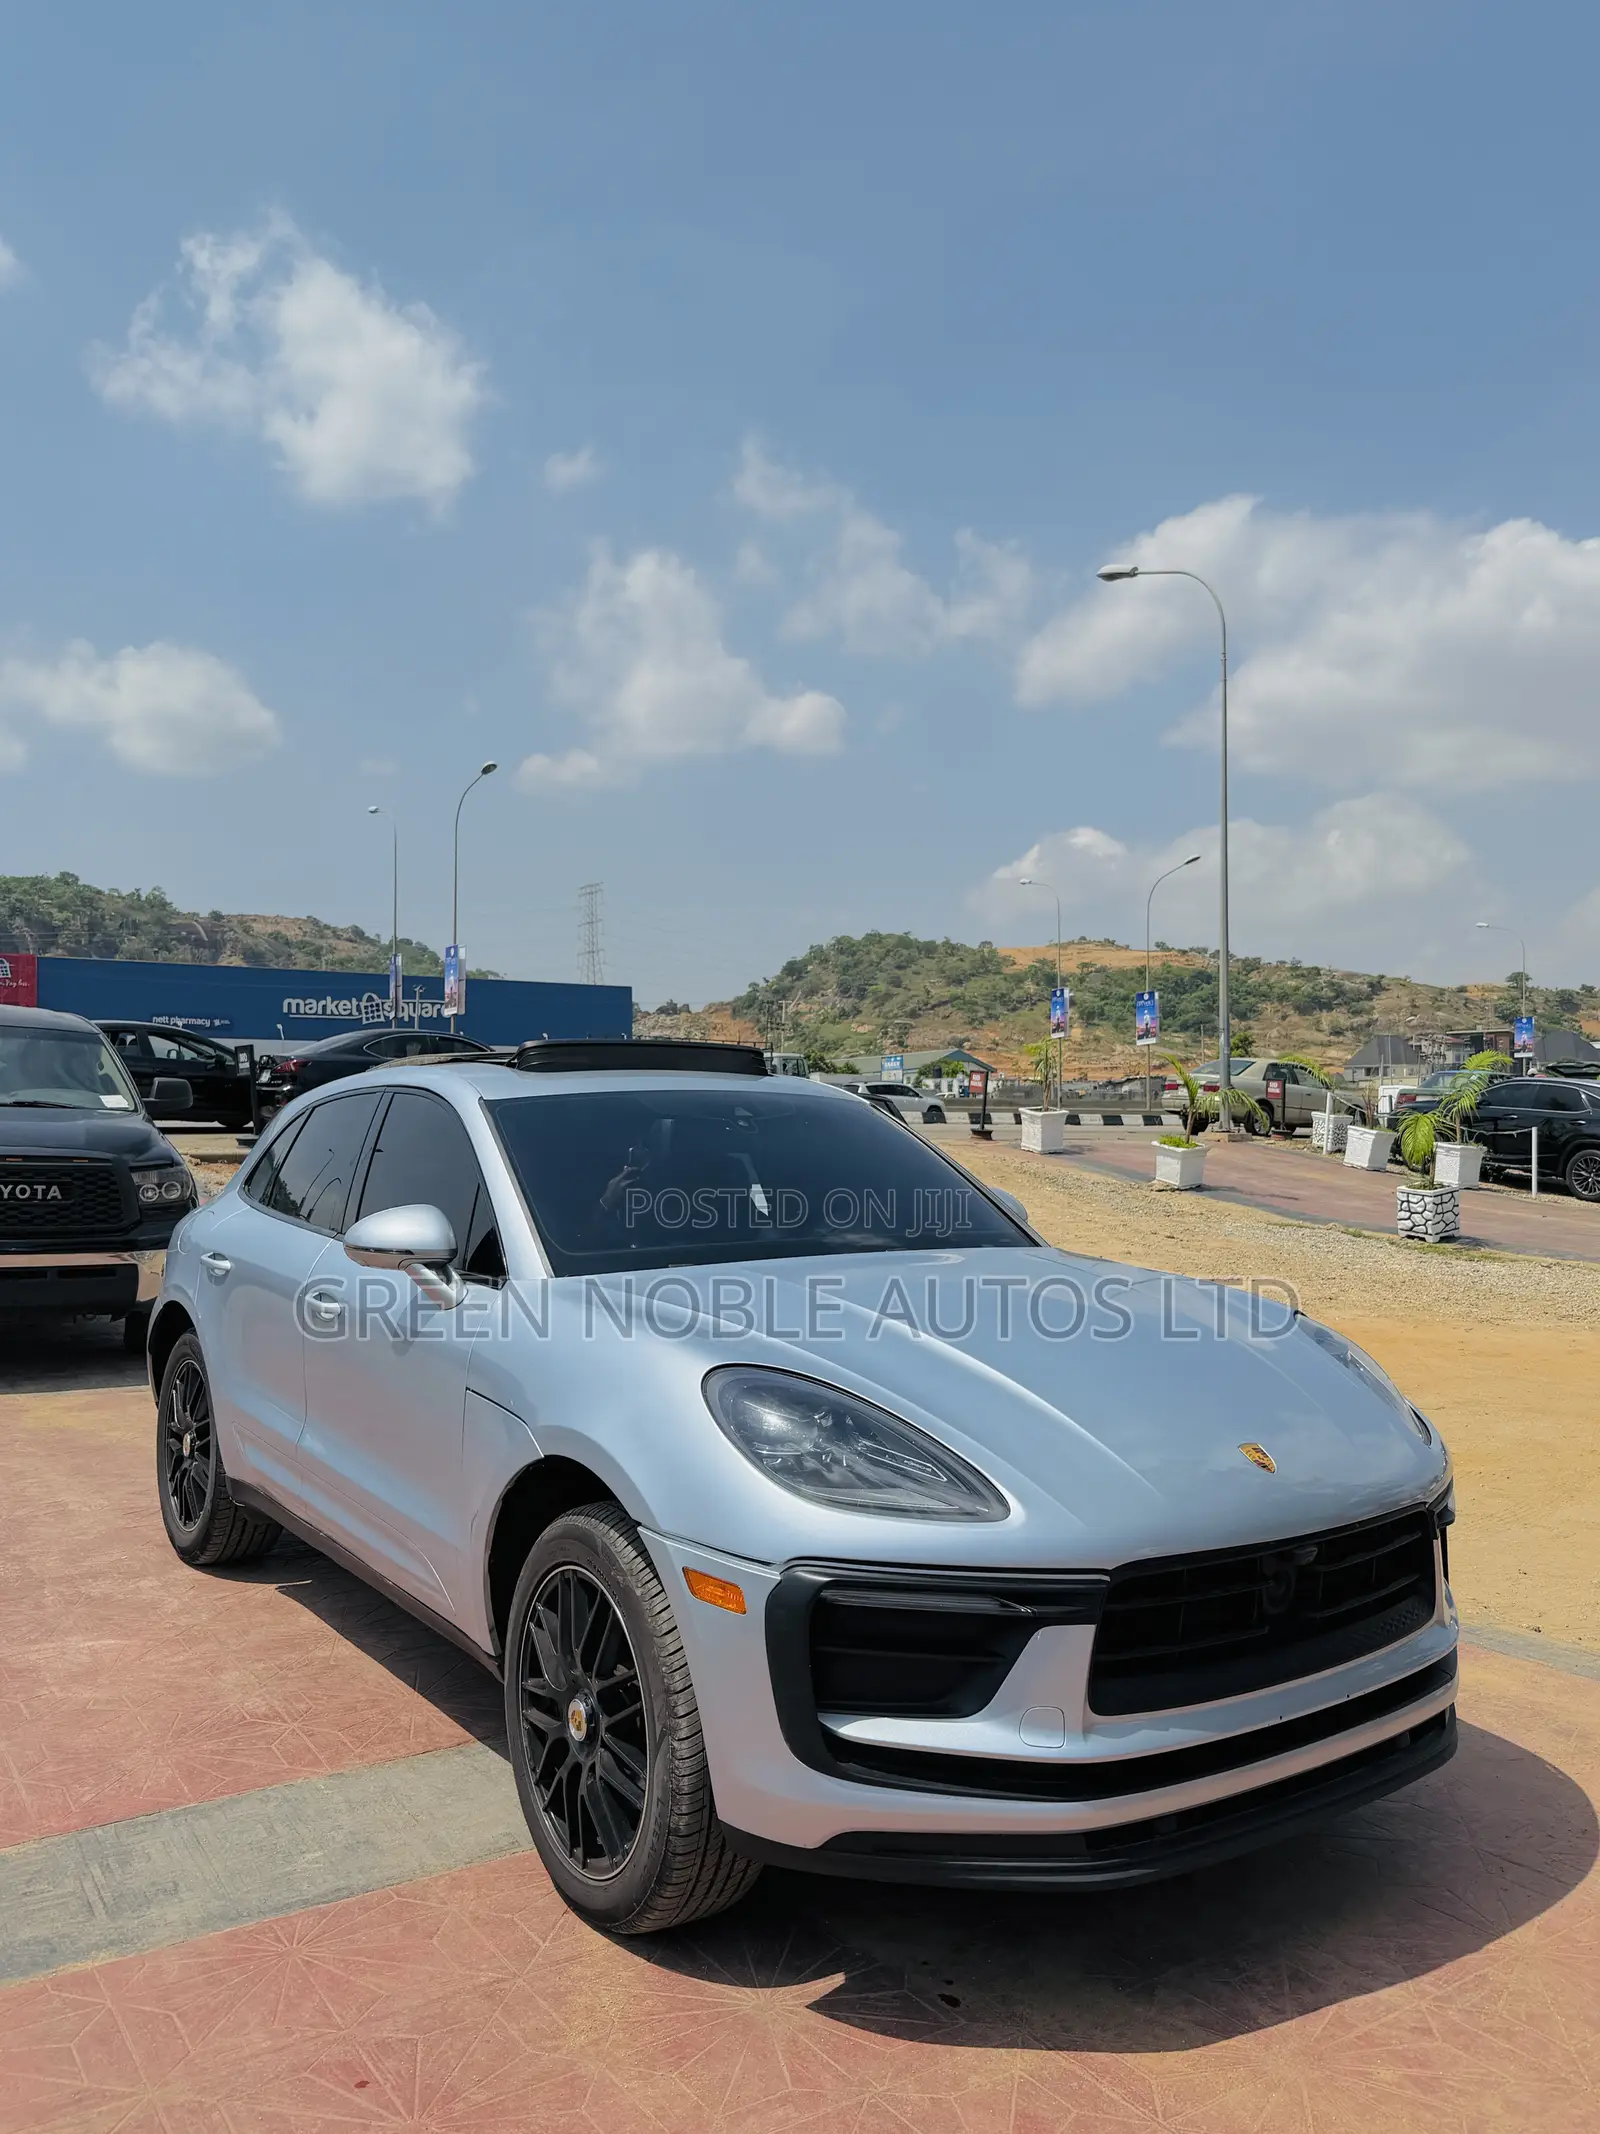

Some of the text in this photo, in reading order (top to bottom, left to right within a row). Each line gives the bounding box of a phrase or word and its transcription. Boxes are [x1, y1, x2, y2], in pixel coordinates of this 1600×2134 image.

[282, 996, 360, 1015] market
[152, 1016, 169, 1024] nett
[170, 1016, 211, 1028] pharmacy
[0, 1184, 63, 1200] YOTA
